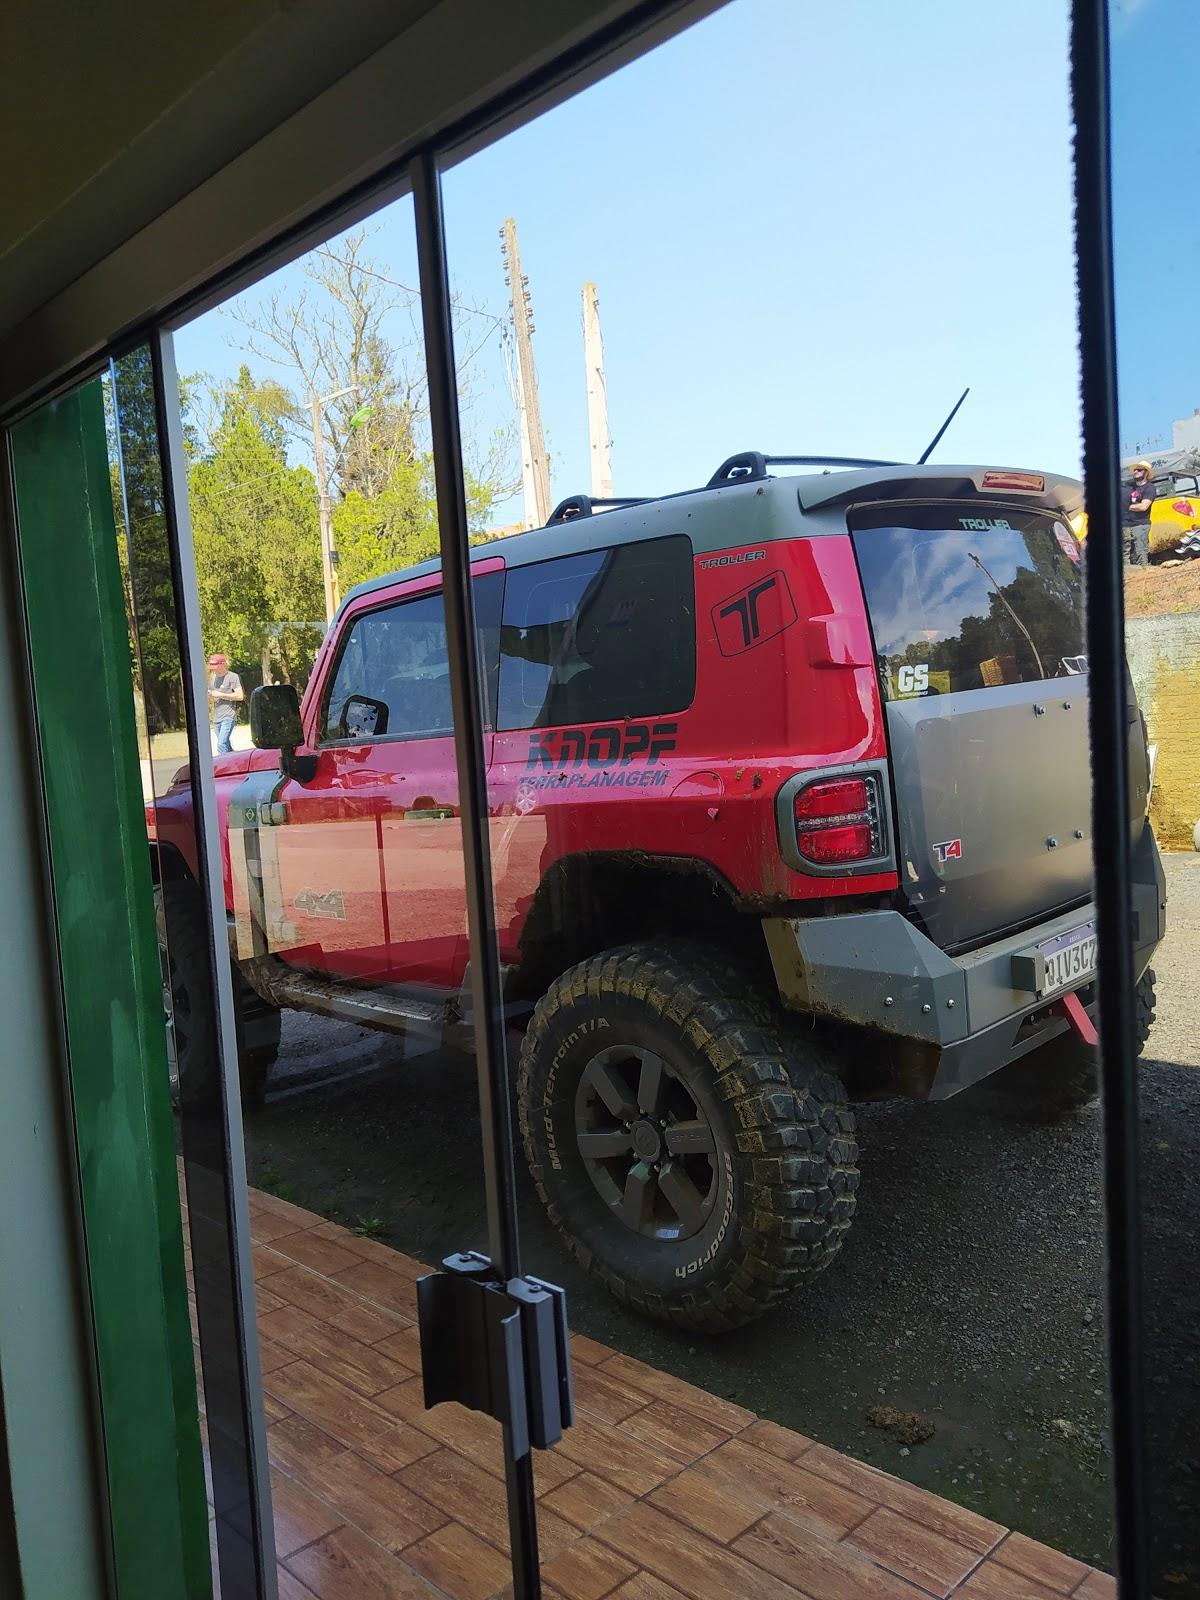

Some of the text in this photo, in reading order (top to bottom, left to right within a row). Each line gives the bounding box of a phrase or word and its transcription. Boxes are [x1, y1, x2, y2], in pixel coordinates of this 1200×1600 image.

[958, 518, 1011, 531] TROLLER
[700, 550, 766, 569] TROLLER
[898, 664, 929, 693] GS
[525, 722, 678, 771] KNOPF
[519, 769, 671, 790] TERRAPLANAGEM
[932, 838, 962, 862] T4
[544, 1017, 610, 1170] Mud-Terrain T/A
[675, 1151, 734, 1279] BFGoodrich
